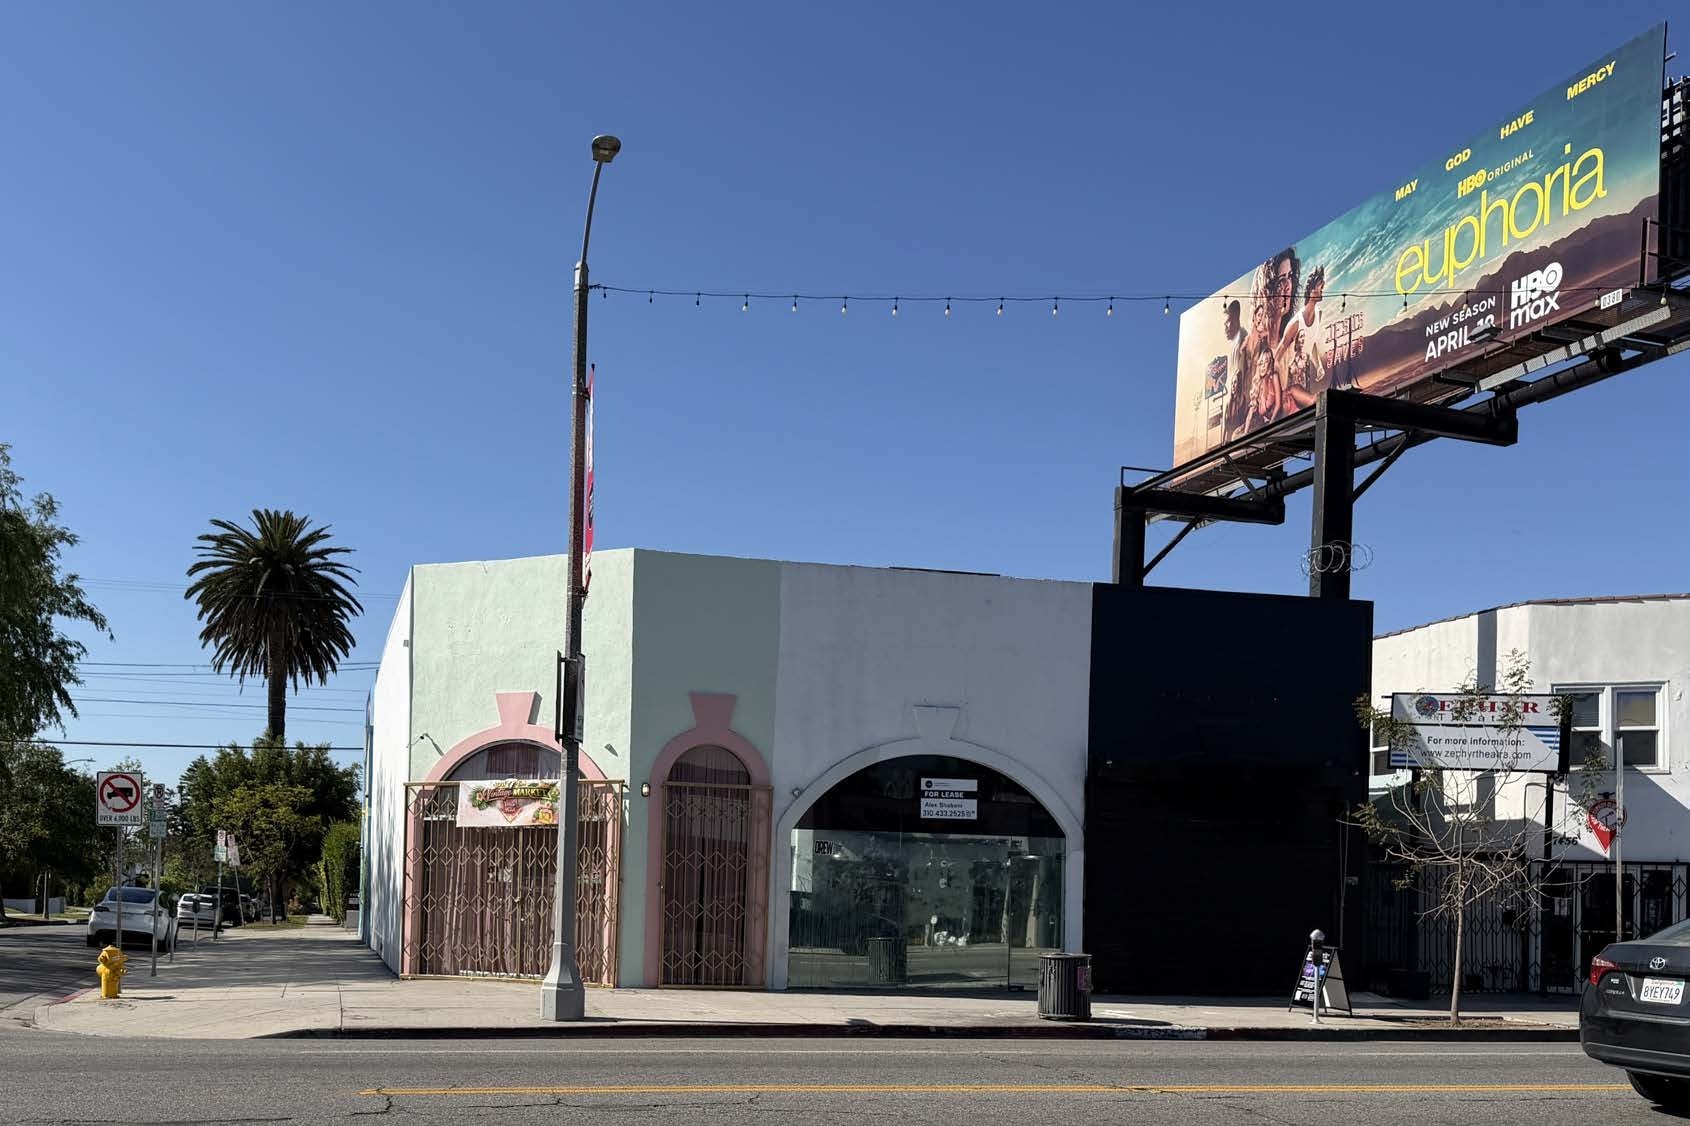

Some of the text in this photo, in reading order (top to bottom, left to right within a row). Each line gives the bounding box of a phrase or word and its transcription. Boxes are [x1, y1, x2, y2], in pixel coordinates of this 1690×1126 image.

[1395, 61, 1617, 201] MAY GOD HAVE MERCY
[1457, 149, 1534, 199] HBO ORIGINAL
[1395, 143, 1607, 294] euphoria
[1511, 261, 1563, 310] HBO
[1426, 295, 1496, 337] NEW SEASON
[1510, 291, 1560, 330] max
[1425, 325, 1472, 362] APRIL
[1427, 736, 1441, 745] For
[1444, 737, 1467, 746] more
[512, 788, 549, 798] MARKET
[941, 791, 964, 799] LEASE
